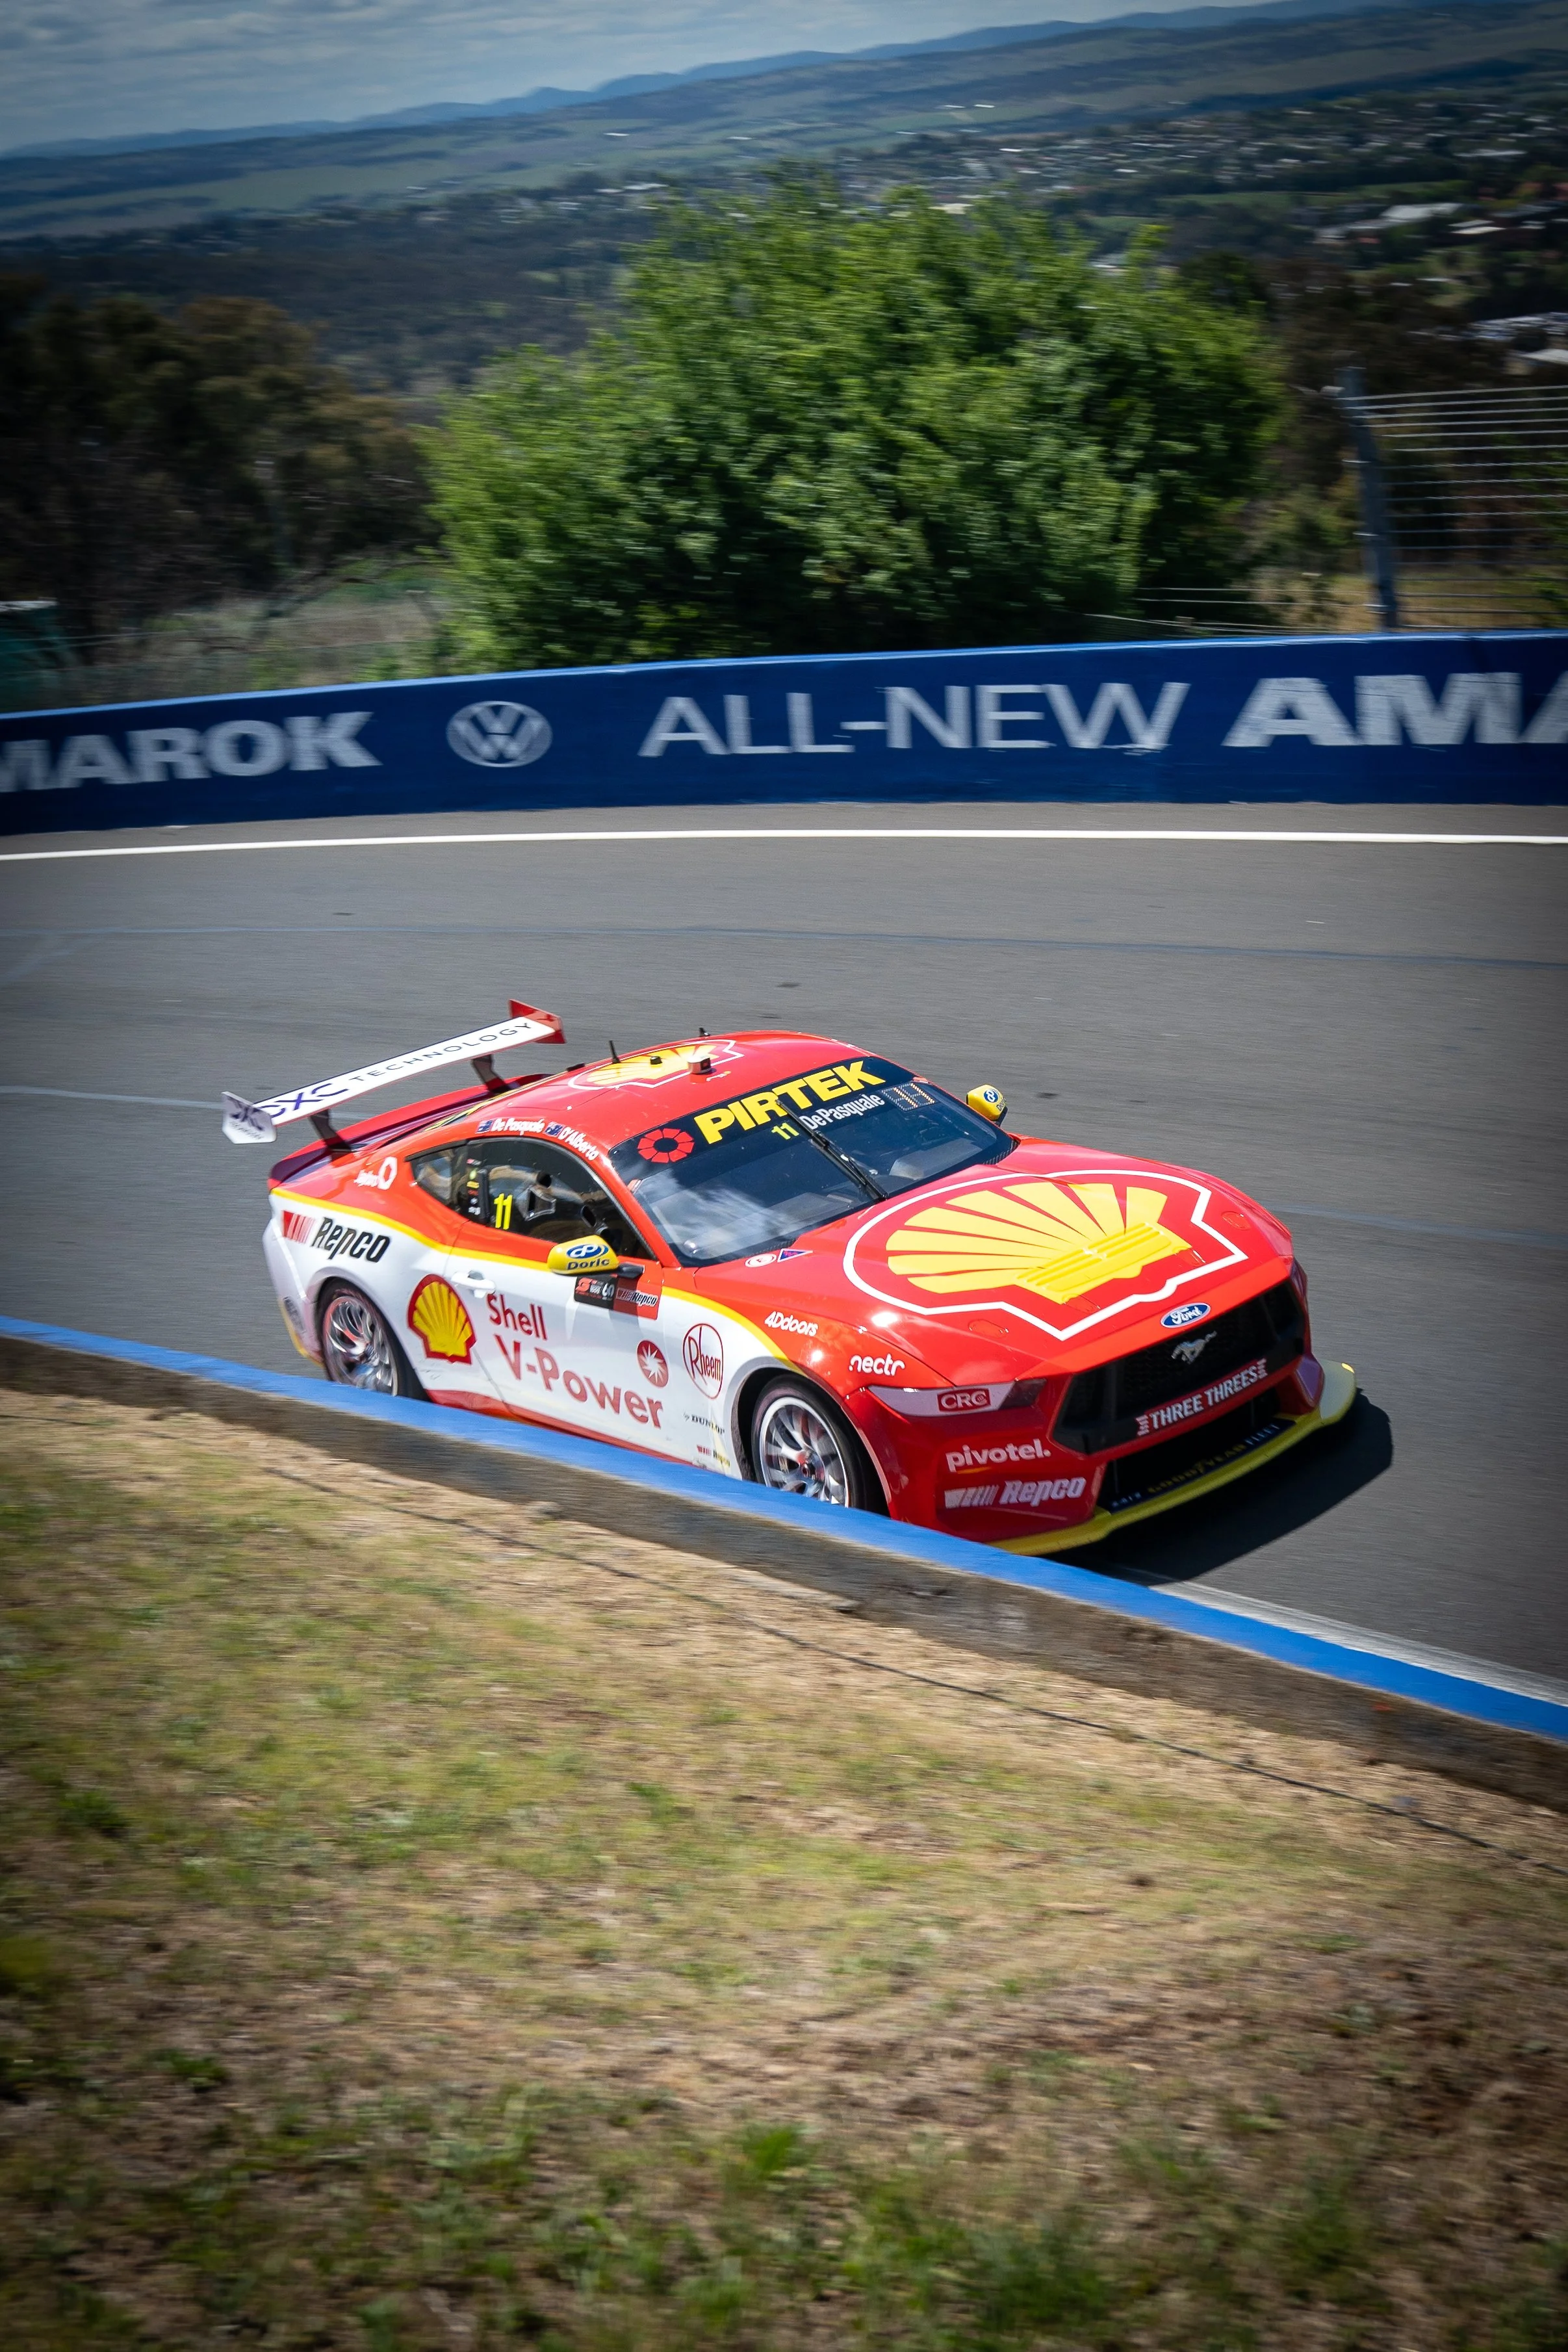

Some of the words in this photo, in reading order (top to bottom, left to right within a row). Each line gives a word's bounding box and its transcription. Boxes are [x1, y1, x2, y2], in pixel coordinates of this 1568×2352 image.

[638, 682, 1190, 756] ALL-NEW
[348, 1022, 532, 1082] TECHNOLOGY
[693, 1061, 886, 1144] PIRTEK
[771, 1122, 800, 1140] 11
[494, 1193, 513, 1230] 11
[310, 1217, 390, 1263] Repco
[567, 1258, 610, 1271] Doric
[487, 1293, 548, 1341] Shell
[764, 1311, 819, 1337] 4Ddoors
[1170, 1306, 1203, 1325] Ford
[688, 1326, 721, 1386] Rheem
[849, 1353, 905, 1376] nectr
[494, 1334, 663, 1430] V-Power
[941, 1391, 987, 1409] CRC
[1149, 1393, 1204, 1430] THREE
[1203, 1365, 1258, 1407] THREES
[999, 1477, 1086, 1507] Repco
